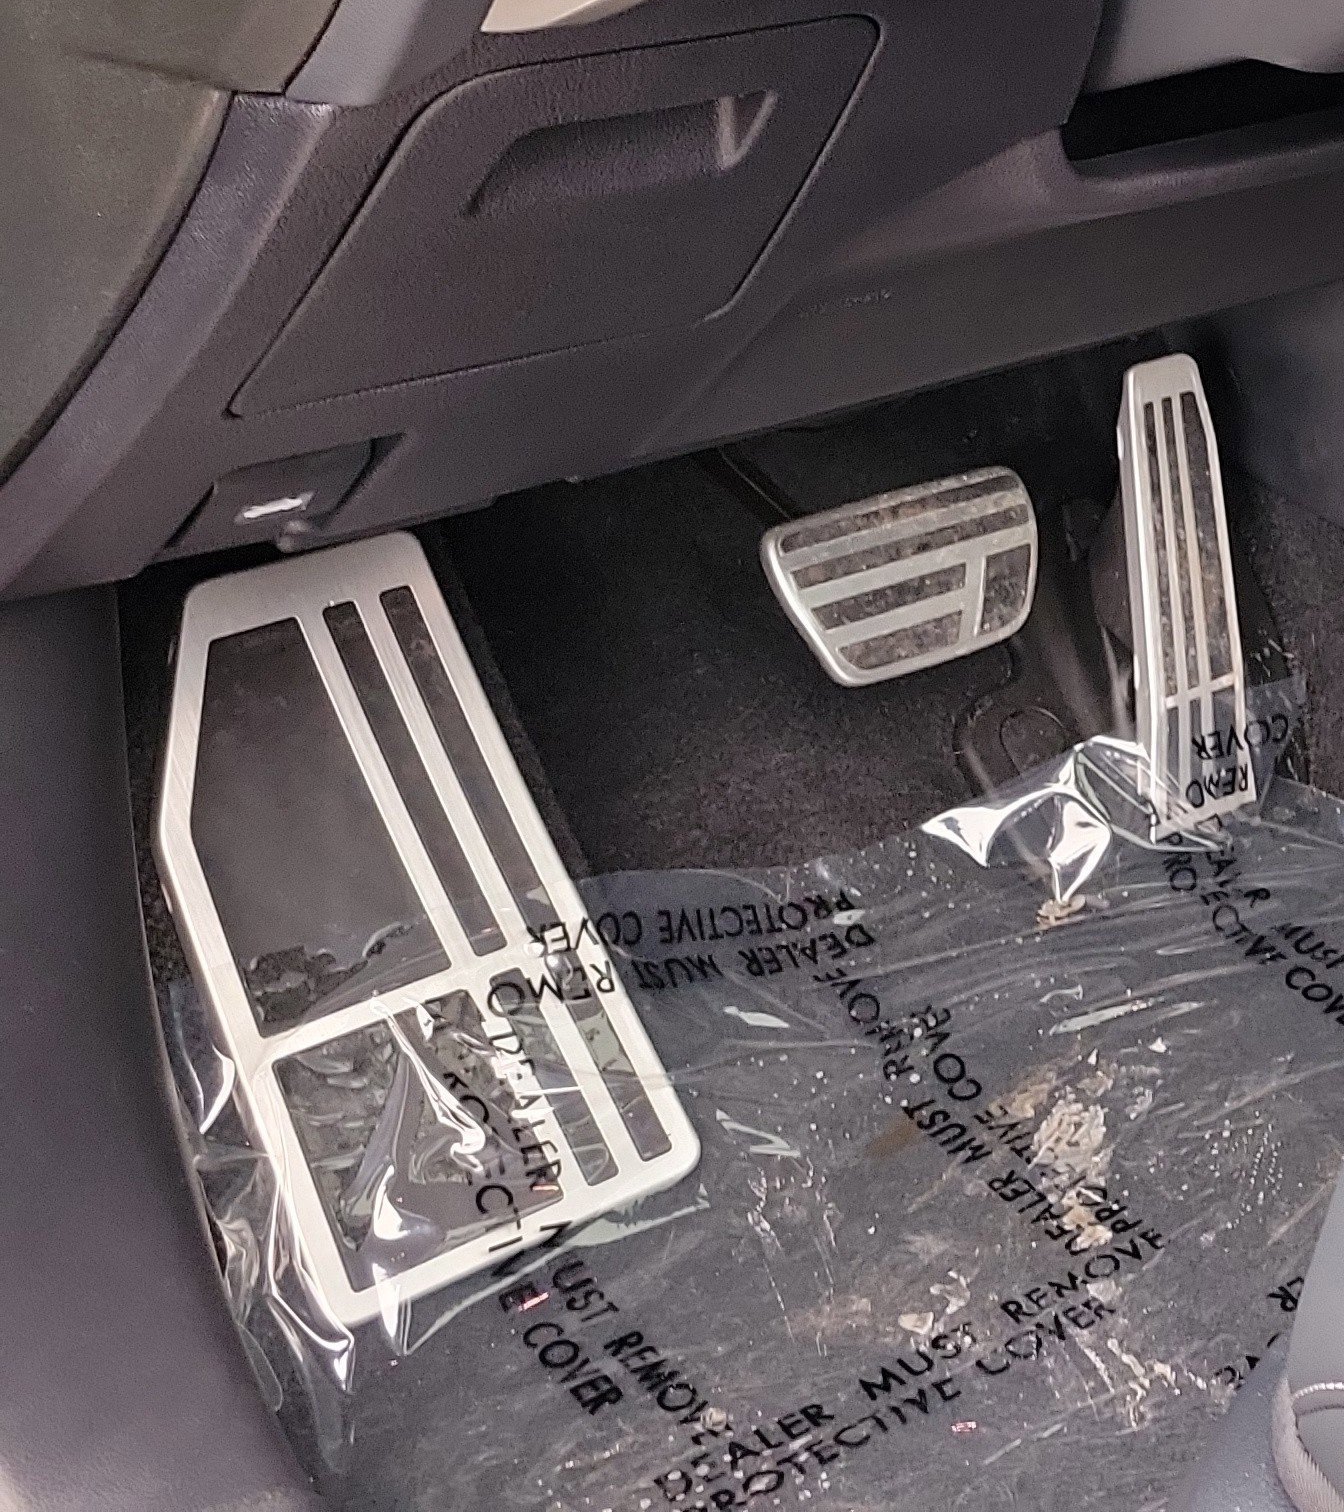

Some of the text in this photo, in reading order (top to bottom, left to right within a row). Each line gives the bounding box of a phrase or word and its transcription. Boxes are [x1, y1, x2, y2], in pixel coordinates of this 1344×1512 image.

[1191, 713, 1289, 760] COVER
[1185, 763, 1249, 808] REMO
[526, 890, 856, 953] PROTECTIVE COVER
[1161, 832, 1288, 965] PROECTIVE
[487, 923, 875, 1017] DEALER MUST REMO
[903, 1098, 993, 1164] MUST
[523, 1321, 623, 1416] COVER
[654, 1228, 1164, 1502] DEALER MUST REMOVE
[975, 1299, 1117, 1376] COVER
